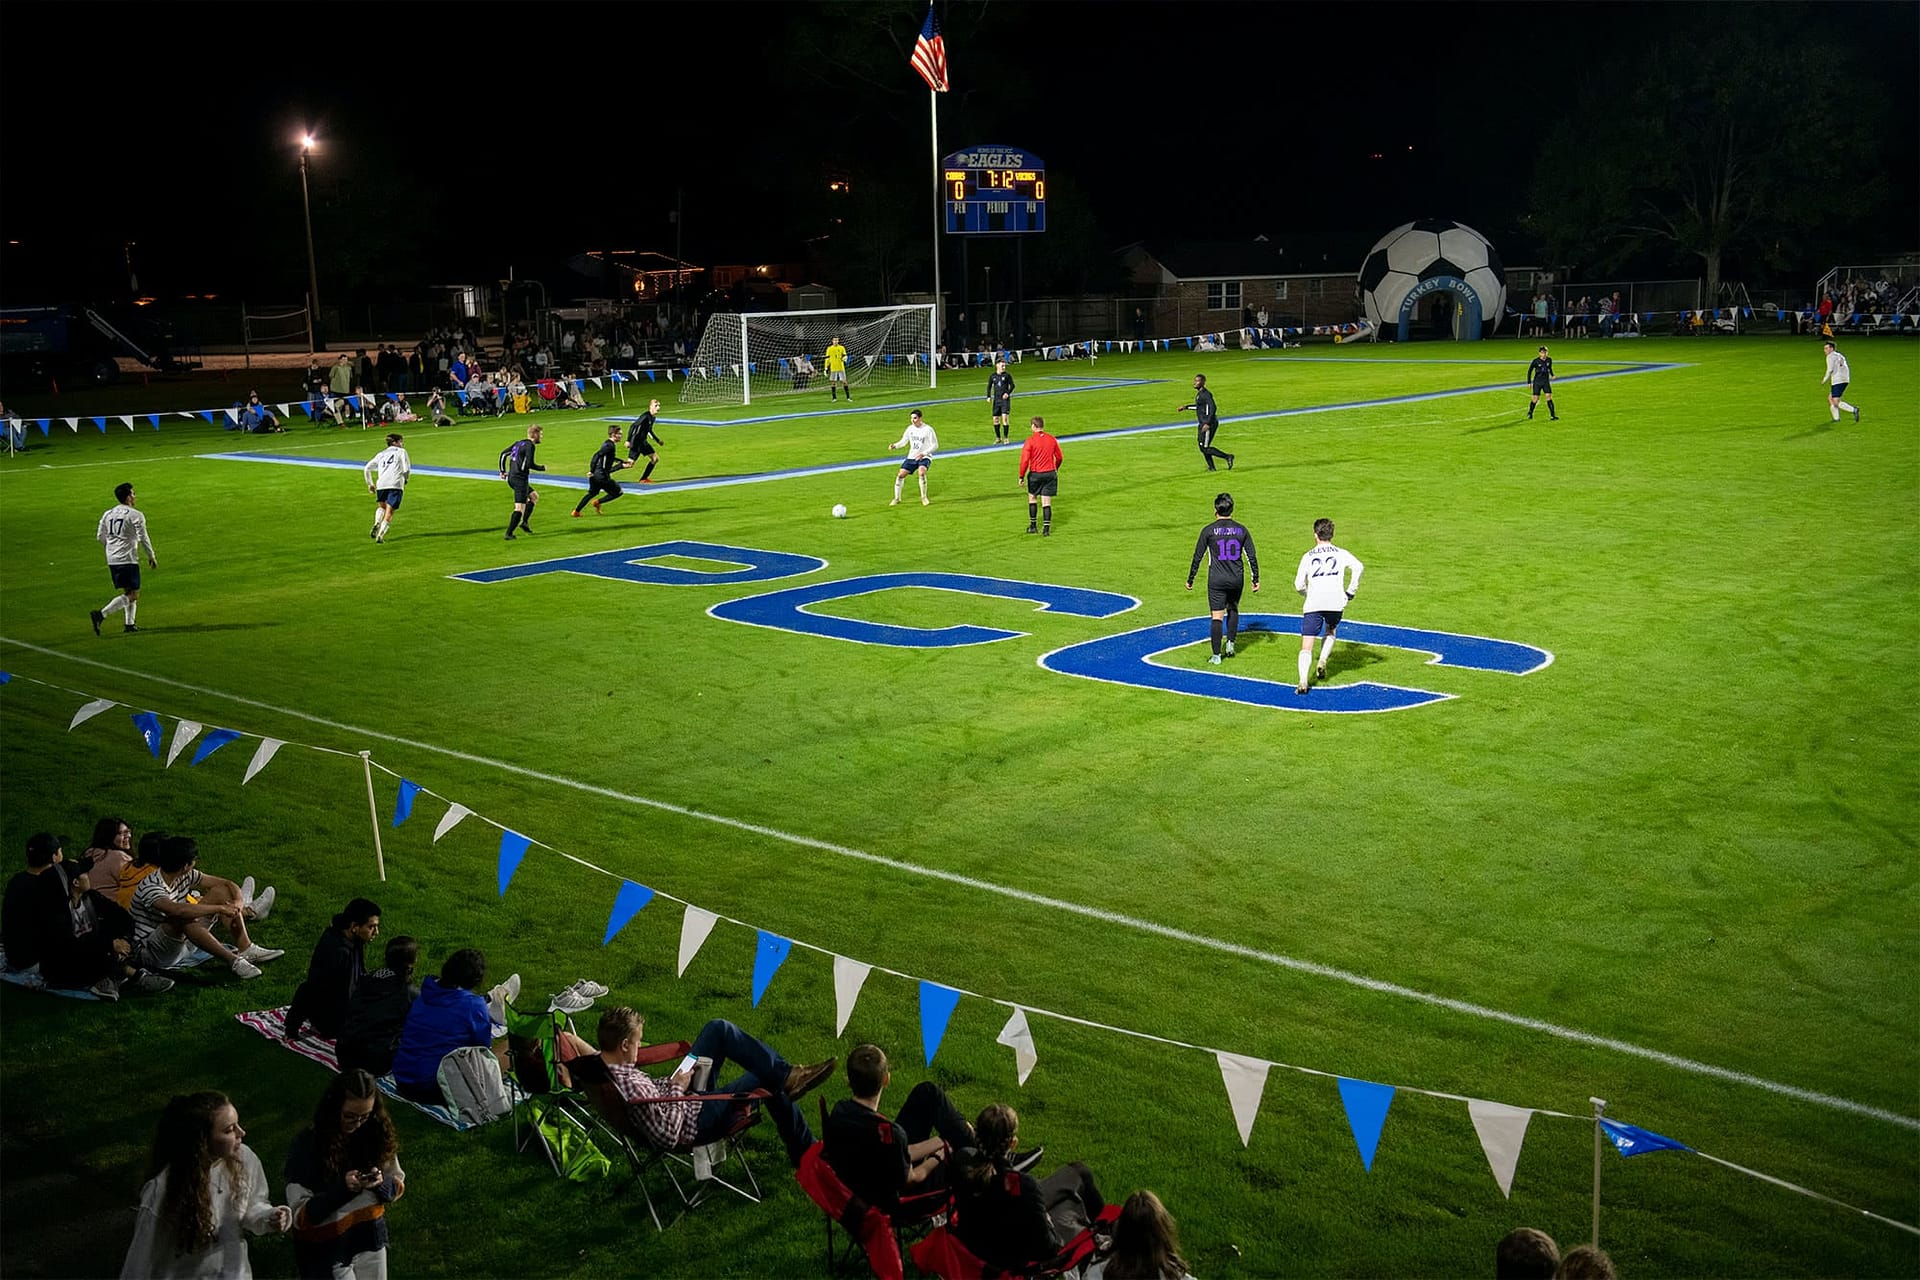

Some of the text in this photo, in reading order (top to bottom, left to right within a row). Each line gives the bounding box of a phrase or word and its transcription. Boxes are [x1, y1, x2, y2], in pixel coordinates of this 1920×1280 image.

[968, 154, 1023, 168] EAGLES
[987, 170, 1013, 188] 7:12
[955, 181, 963, 200] 0
[1035, 181, 1044, 200] 0
[1402, 279, 1475, 312] TURKEY BOWL
[109, 518, 123, 535] 17
[1217, 539, 1241, 561] 10
[1311, 556, 1339, 578] 22
